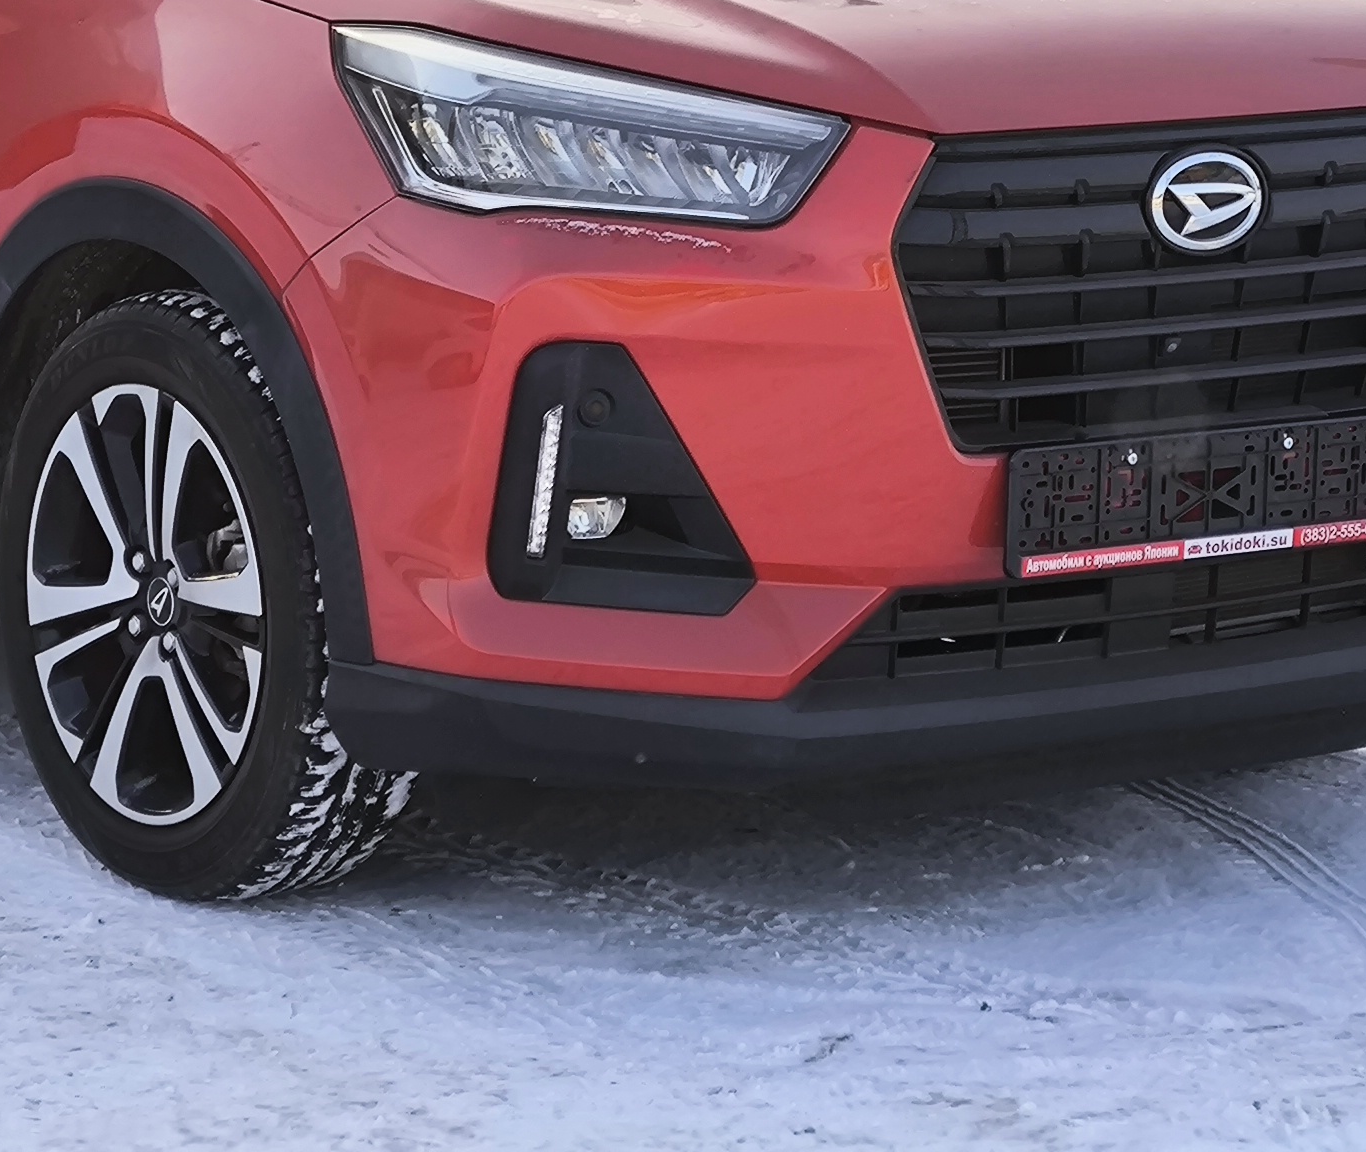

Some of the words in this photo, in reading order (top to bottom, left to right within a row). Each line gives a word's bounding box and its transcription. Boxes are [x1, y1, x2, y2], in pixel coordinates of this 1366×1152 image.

[1026, 554, 1085, 574] Автомобили
[1093, 550, 1143, 568] аукционов
[1144, 545, 1180, 560] Японии
[1205, 533, 1288, 555] tokidoki.su
